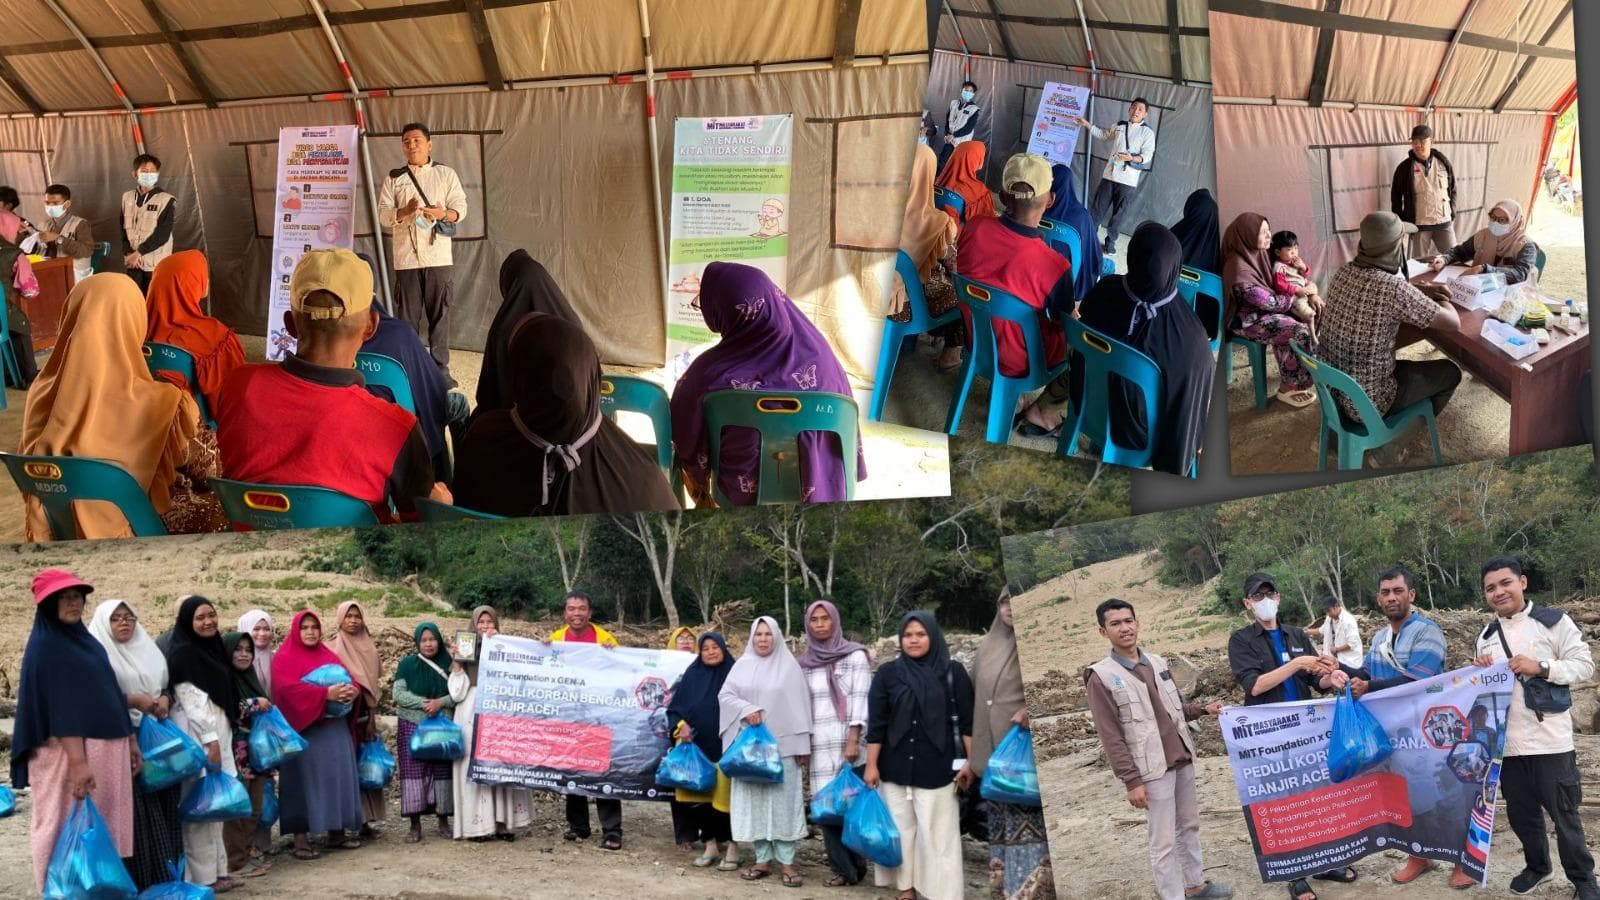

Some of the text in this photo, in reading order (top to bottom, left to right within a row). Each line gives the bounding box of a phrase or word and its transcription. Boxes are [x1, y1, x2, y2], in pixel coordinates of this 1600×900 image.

[709, 146, 738, 154] TIDAK
[743, 145, 786, 154] SENDIRI
[362, 360, 381, 372] MD
[486, 670, 503, 678] MIT
[504, 671, 550, 682] Foundation
[557, 676, 586, 686] GEN-A
[1480, 672, 1508, 686] lpdp
[484, 686, 640, 708] PEDULI KORBAN BENCANA
[483, 700, 560, 715] BANJIR ACEH
[1254, 713, 1300, 732] MASYARAKAT
[1238, 748, 1257, 760] MIT
[1259, 736, 1316, 757] Foundation
[1318, 734, 1324, 742] x
[1243, 736, 1430, 780] PEDULI KOR CANA
[524, 778, 558, 788] MALAYSIA
[1248, 768, 1330, 798] BANJIR ACE
[1272, 806, 1331, 824] Pendampingan
[1278, 834, 1308, 846] Edukasi
[1266, 836, 1368, 868] TERIMAKASIH SAUDARA KAMI
[1276, 866, 1302, 876] NEGERI
[1330, 846, 1367, 864] MALAYSIA
